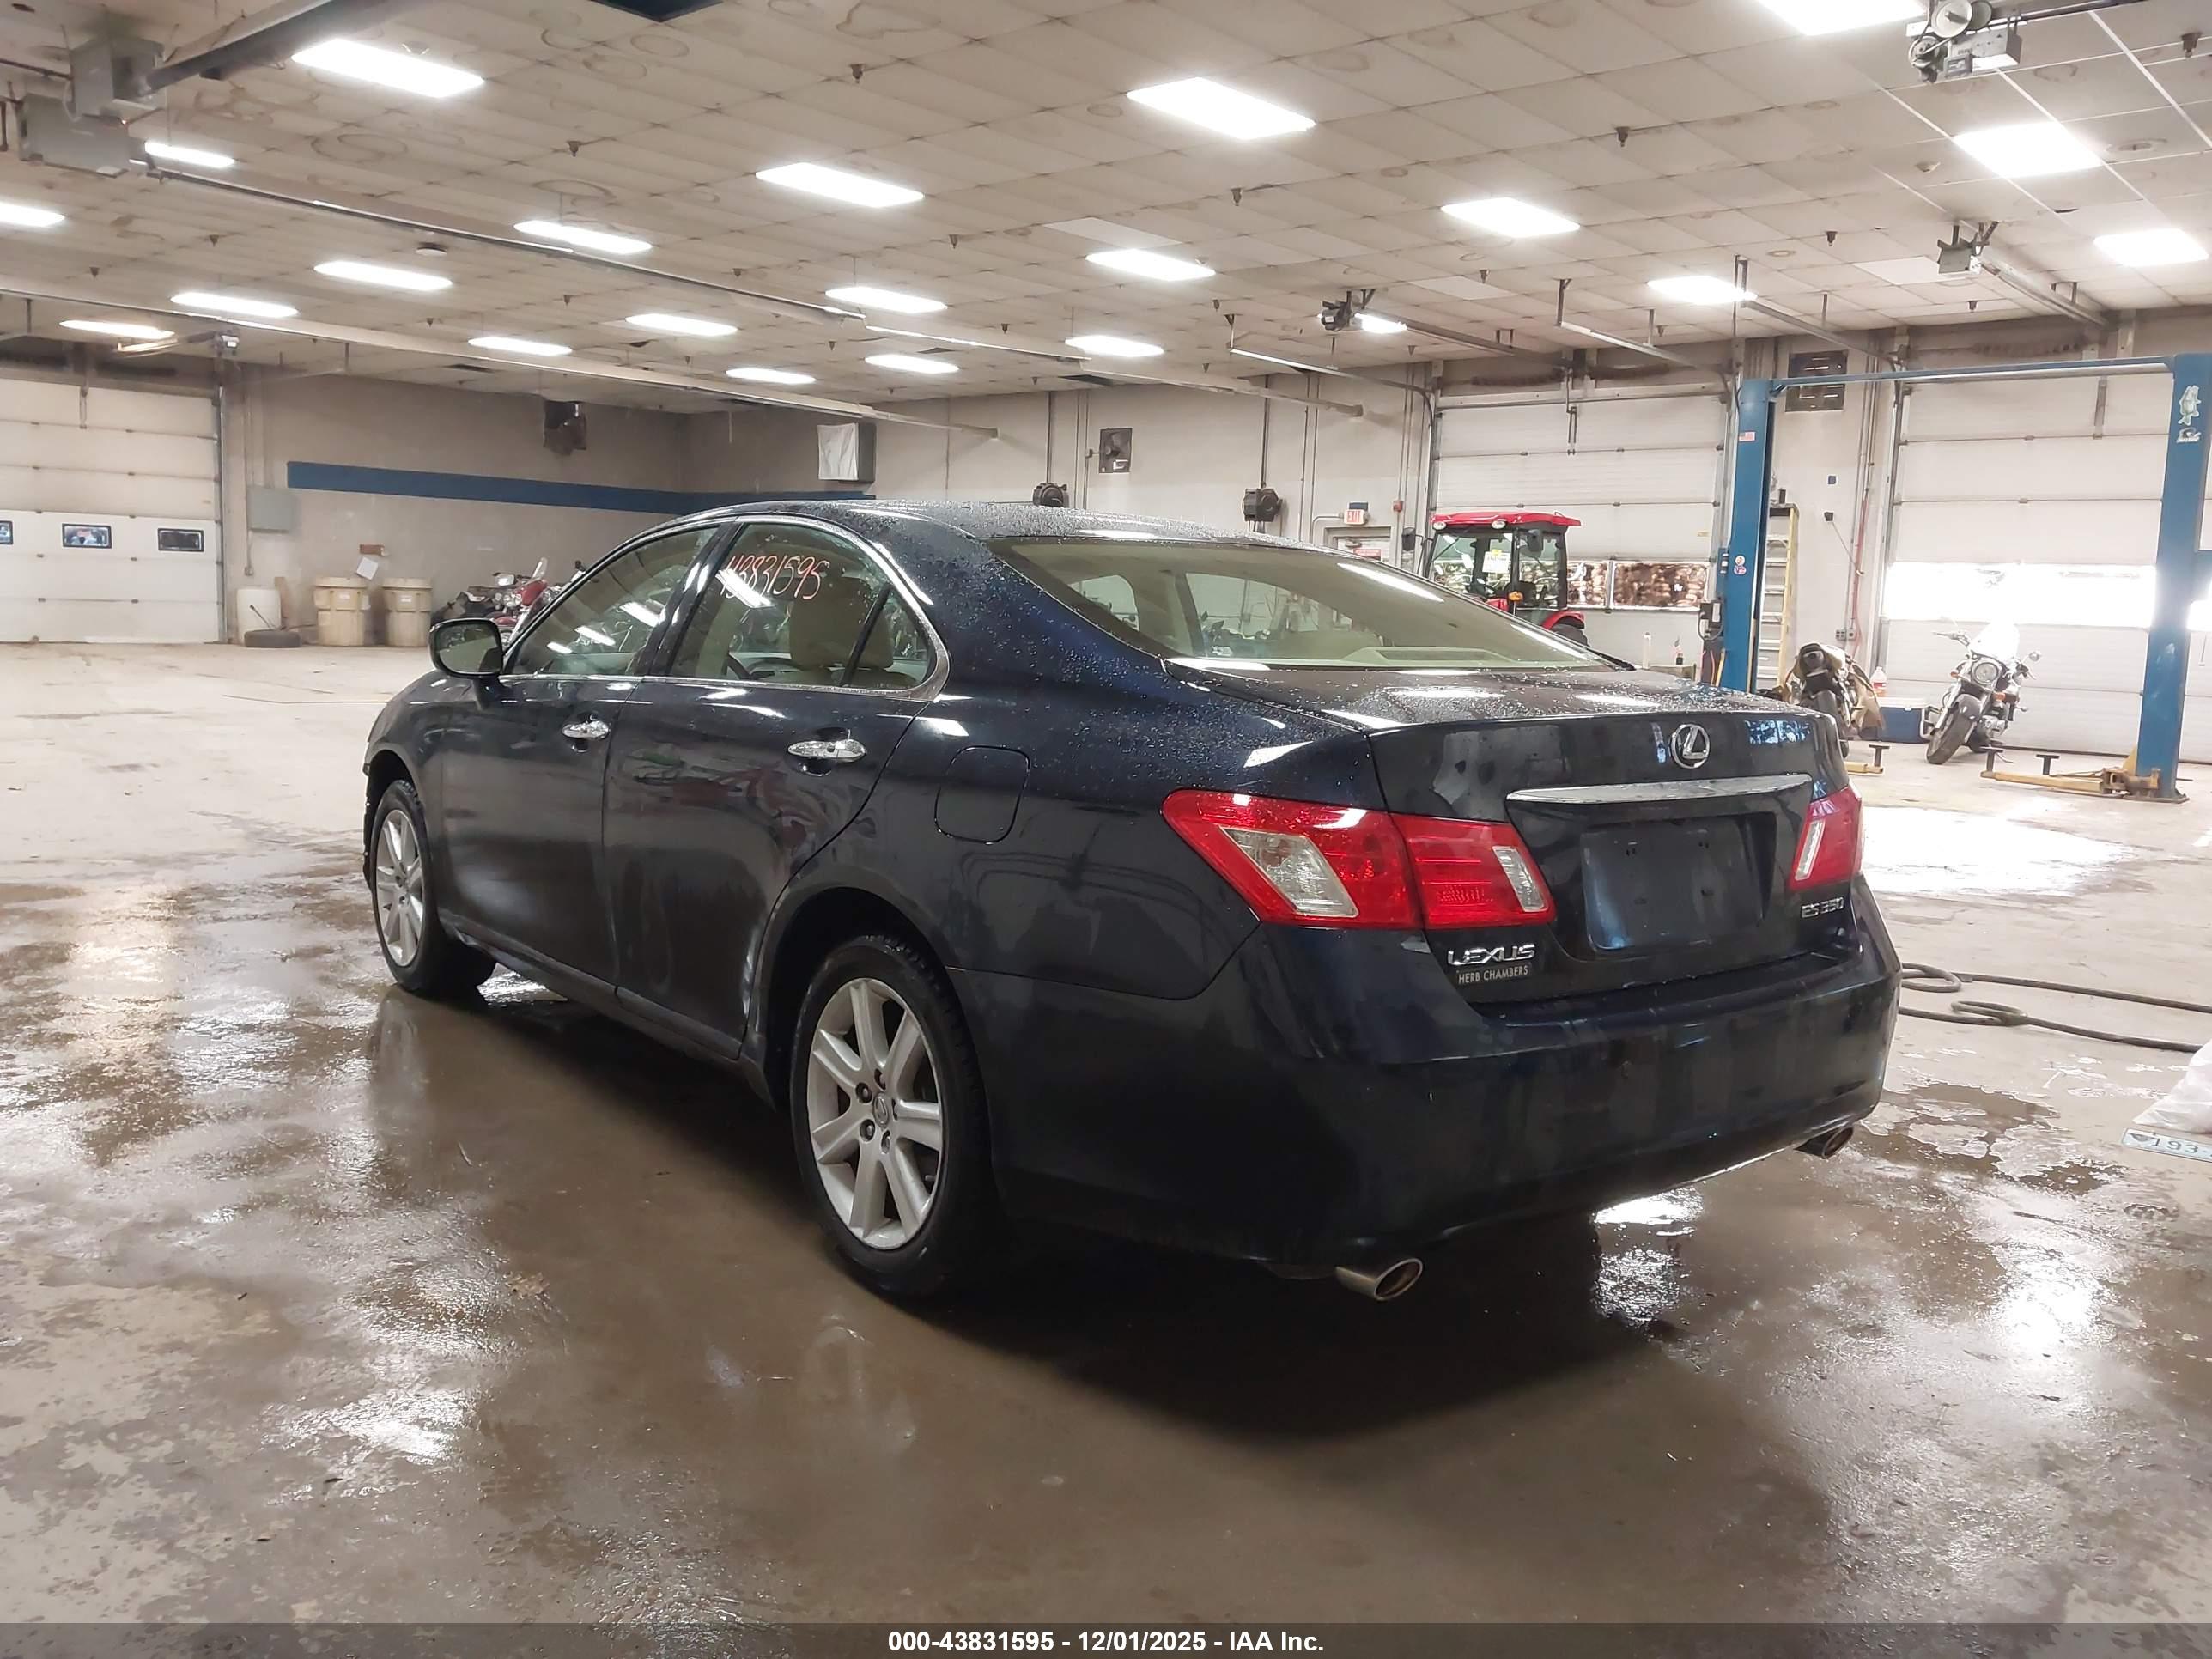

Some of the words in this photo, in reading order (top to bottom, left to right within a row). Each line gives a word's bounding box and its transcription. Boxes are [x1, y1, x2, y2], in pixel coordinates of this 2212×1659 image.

[1346, 510, 1362, 522] EXIT
[720, 554, 830, 600] 43831595
[1802, 902, 1820, 918] ES
[1820, 896, 1844, 915] 350
[1447, 944, 1535, 966] LEXUS
[1458, 971, 1480, 984] HERB
[1483, 965, 1528, 981] CHAMBERS
